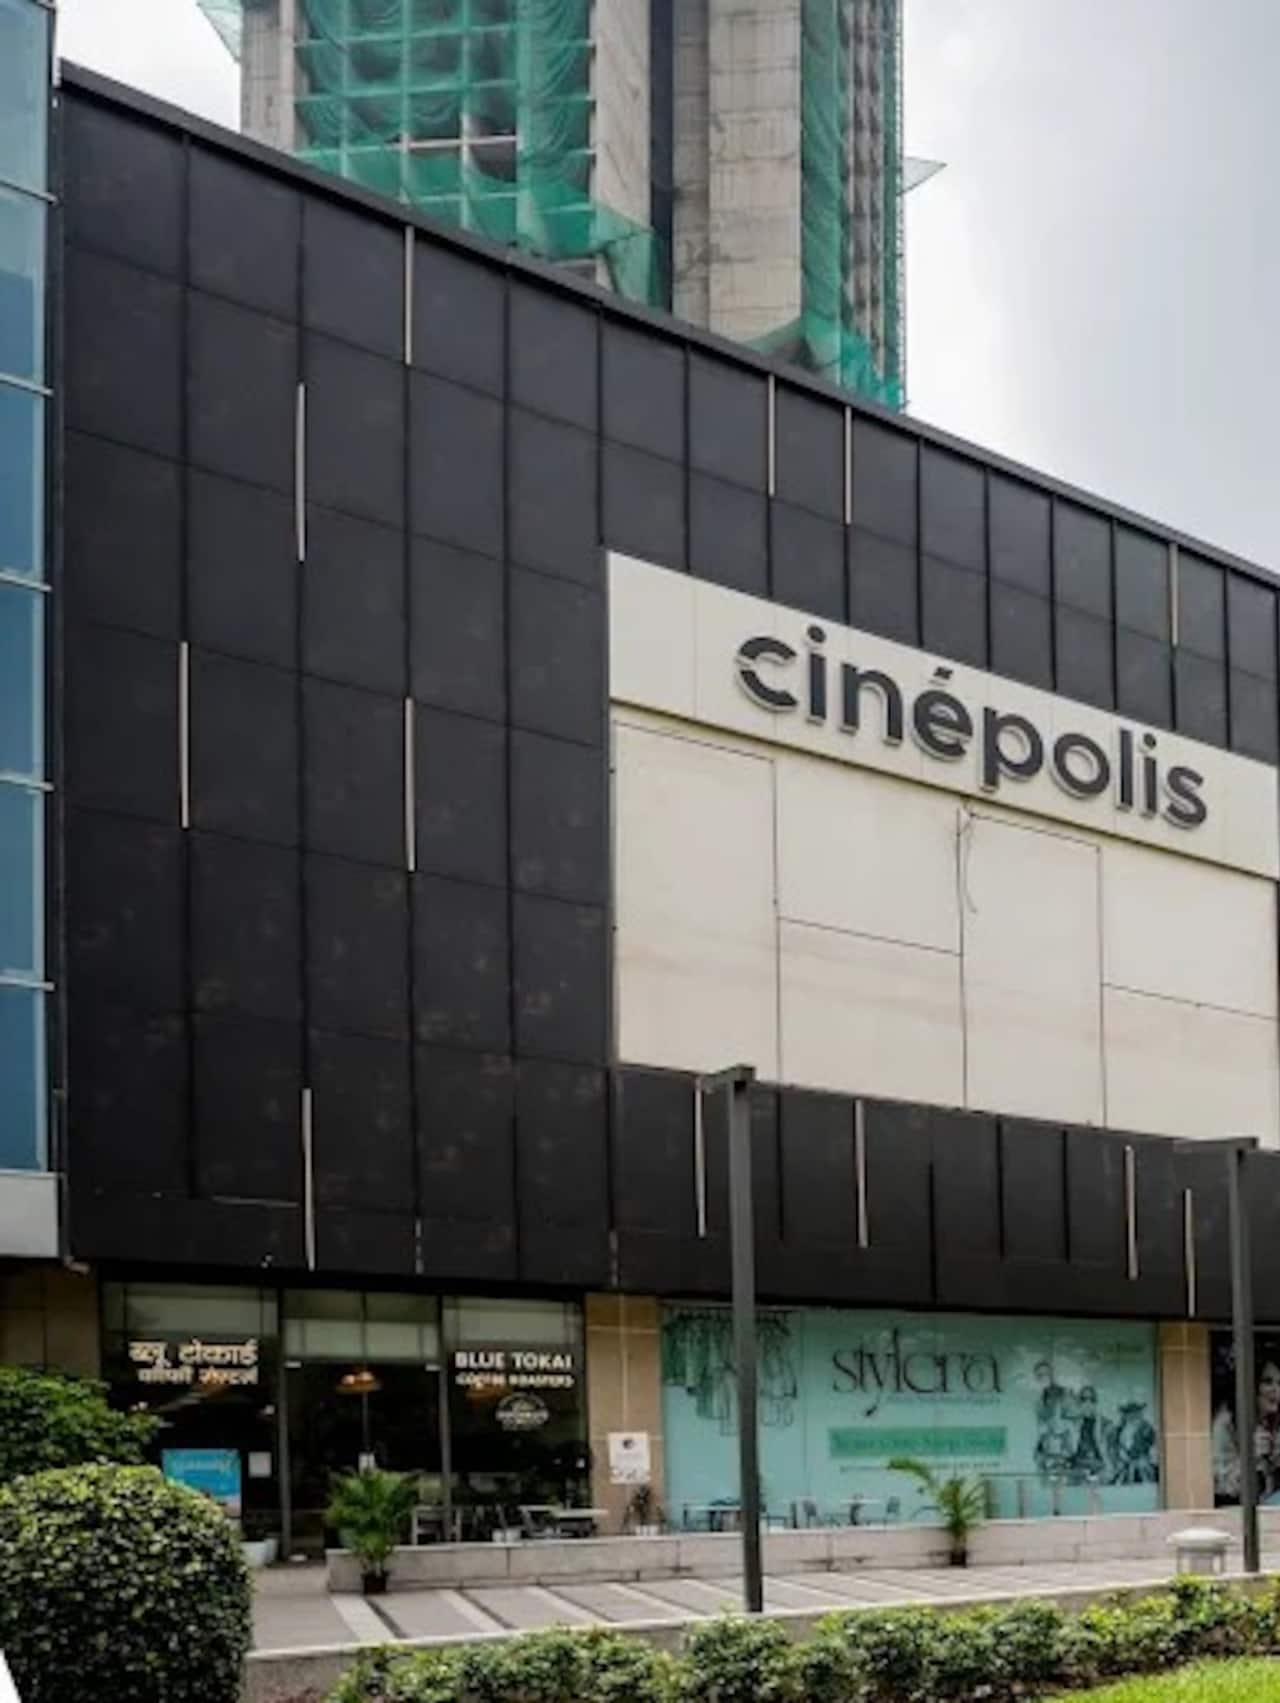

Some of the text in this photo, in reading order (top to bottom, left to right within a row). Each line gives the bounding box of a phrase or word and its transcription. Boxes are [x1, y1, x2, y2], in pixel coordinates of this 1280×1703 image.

[736, 624, 1208, 829] cinépolis
[456, 1352, 572, 1370] BLUE TOKAI
